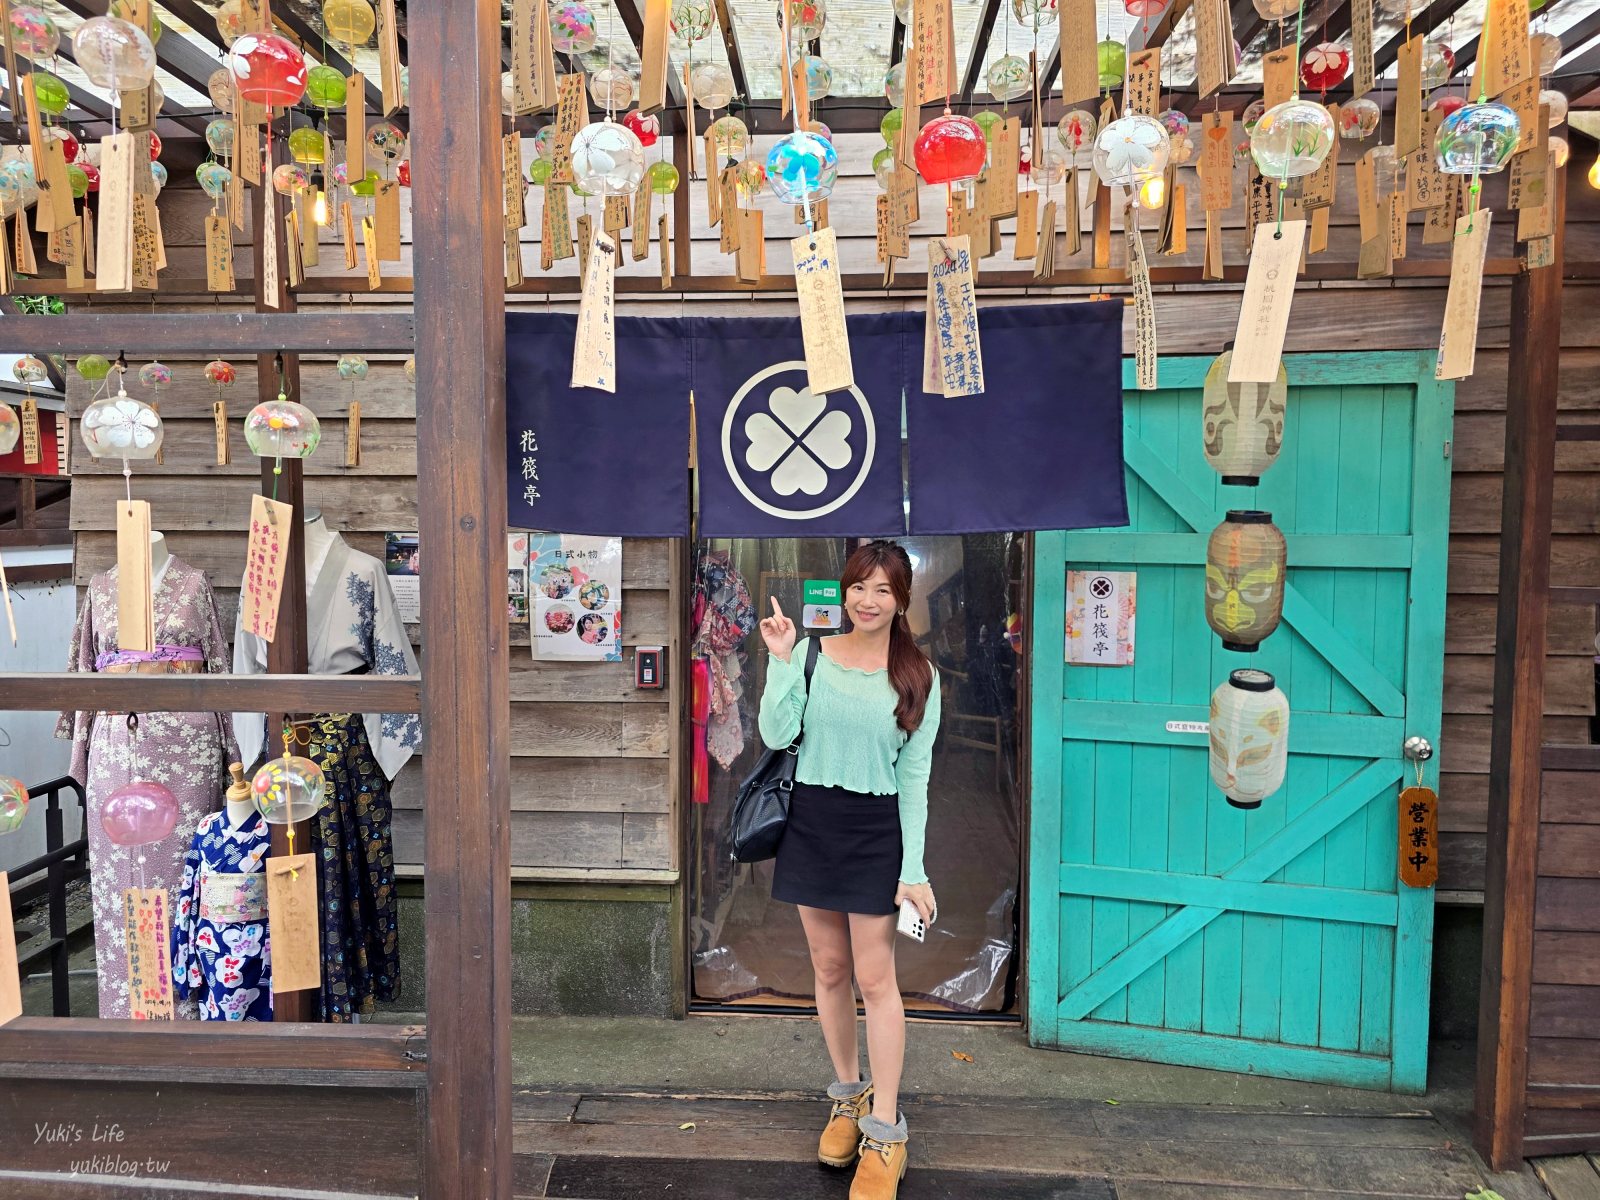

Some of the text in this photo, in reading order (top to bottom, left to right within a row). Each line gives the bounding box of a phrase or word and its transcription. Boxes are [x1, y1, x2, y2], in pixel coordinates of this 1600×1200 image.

[520, 430, 540, 506] 花筏亭
[554, 550, 598, 560] 日式小物
[1092, 604, 1109, 657] 花筏亭
[1408, 802, 1430, 872] 營業中
